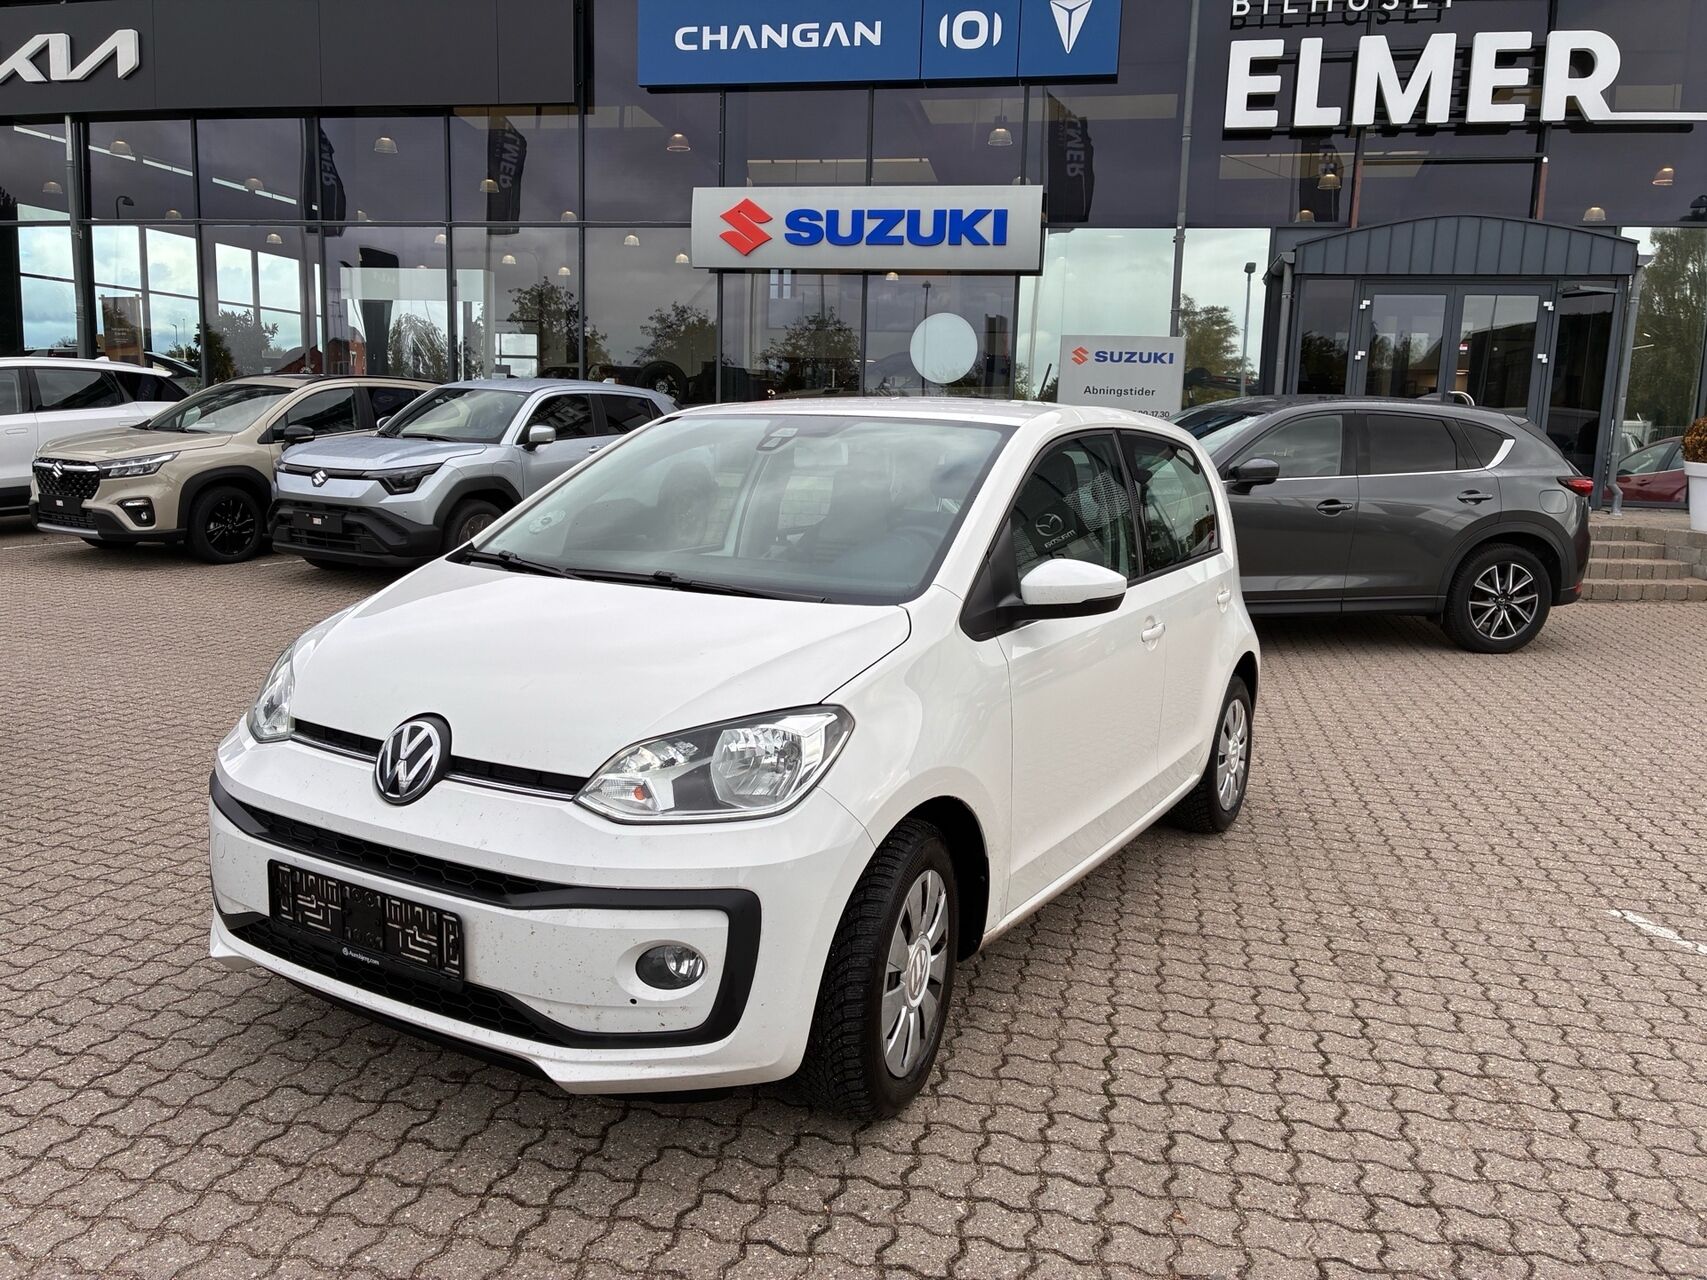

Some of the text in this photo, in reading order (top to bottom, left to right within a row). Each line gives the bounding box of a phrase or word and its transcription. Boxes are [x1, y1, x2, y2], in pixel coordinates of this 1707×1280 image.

[674, 20, 882, 50] CHANGAN
[1224, 30, 1694, 128] ELMER
[784, 208, 1008, 247] SUZUKI
[1094, 350, 1175, 365] SUZUKI
